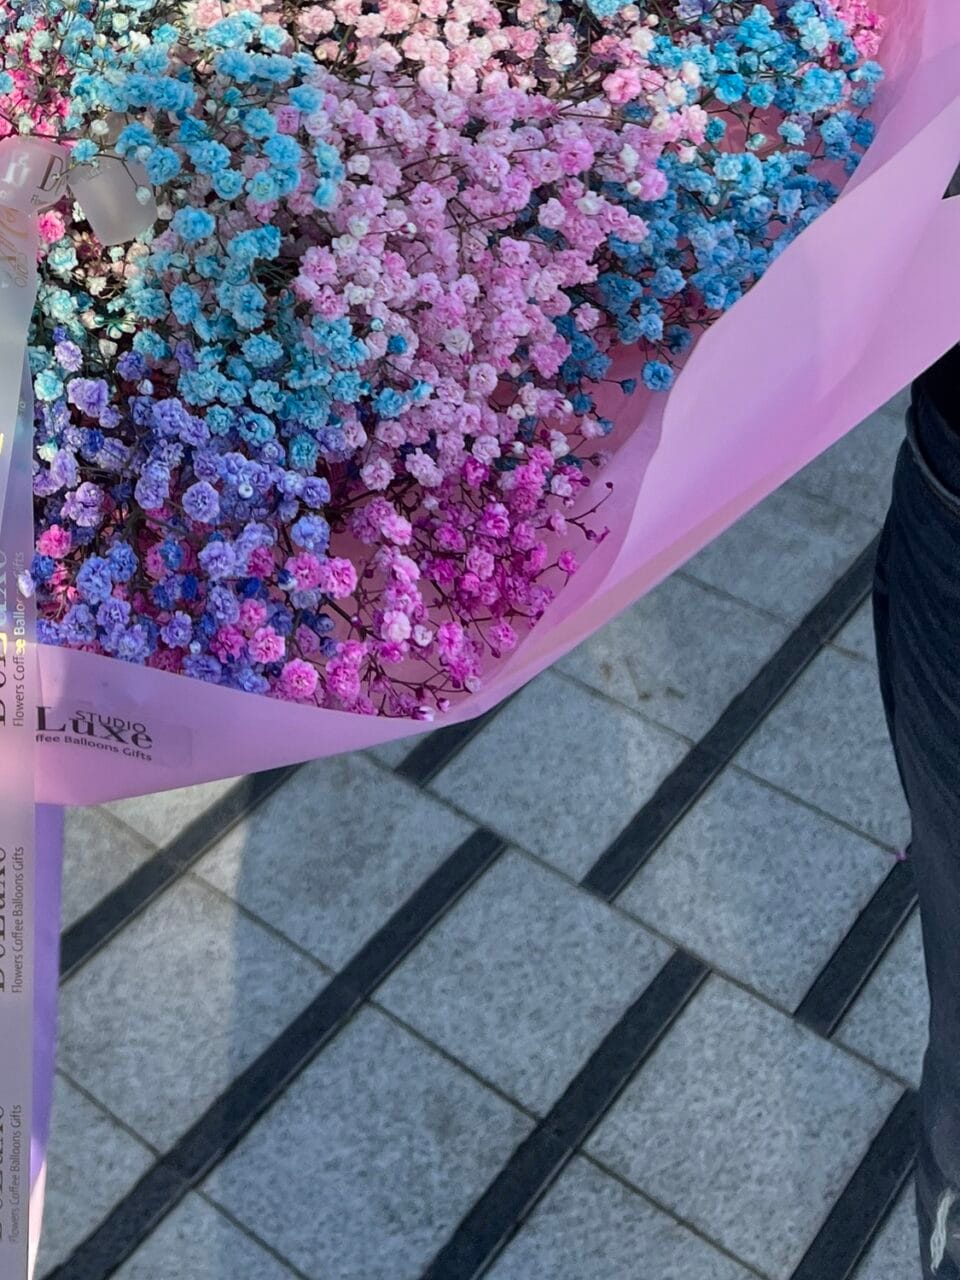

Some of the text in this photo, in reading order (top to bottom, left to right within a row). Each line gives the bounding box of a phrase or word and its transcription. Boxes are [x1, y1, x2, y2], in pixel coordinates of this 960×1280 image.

[13, 681, 24, 727] Flowers
[75, 710, 147, 733] STUDIO
[36, 706, 153, 750] Luxe
[36, 735, 153, 762] ffee Balloons Gifts
[12, 846, 24, 993] Flowers Coffee Balloons Gifts
[10, 1104, 22, 1131] Gifts
[9, 1131, 21, 1171] Balloons
[8, 1175, 20, 1206] Coffee
